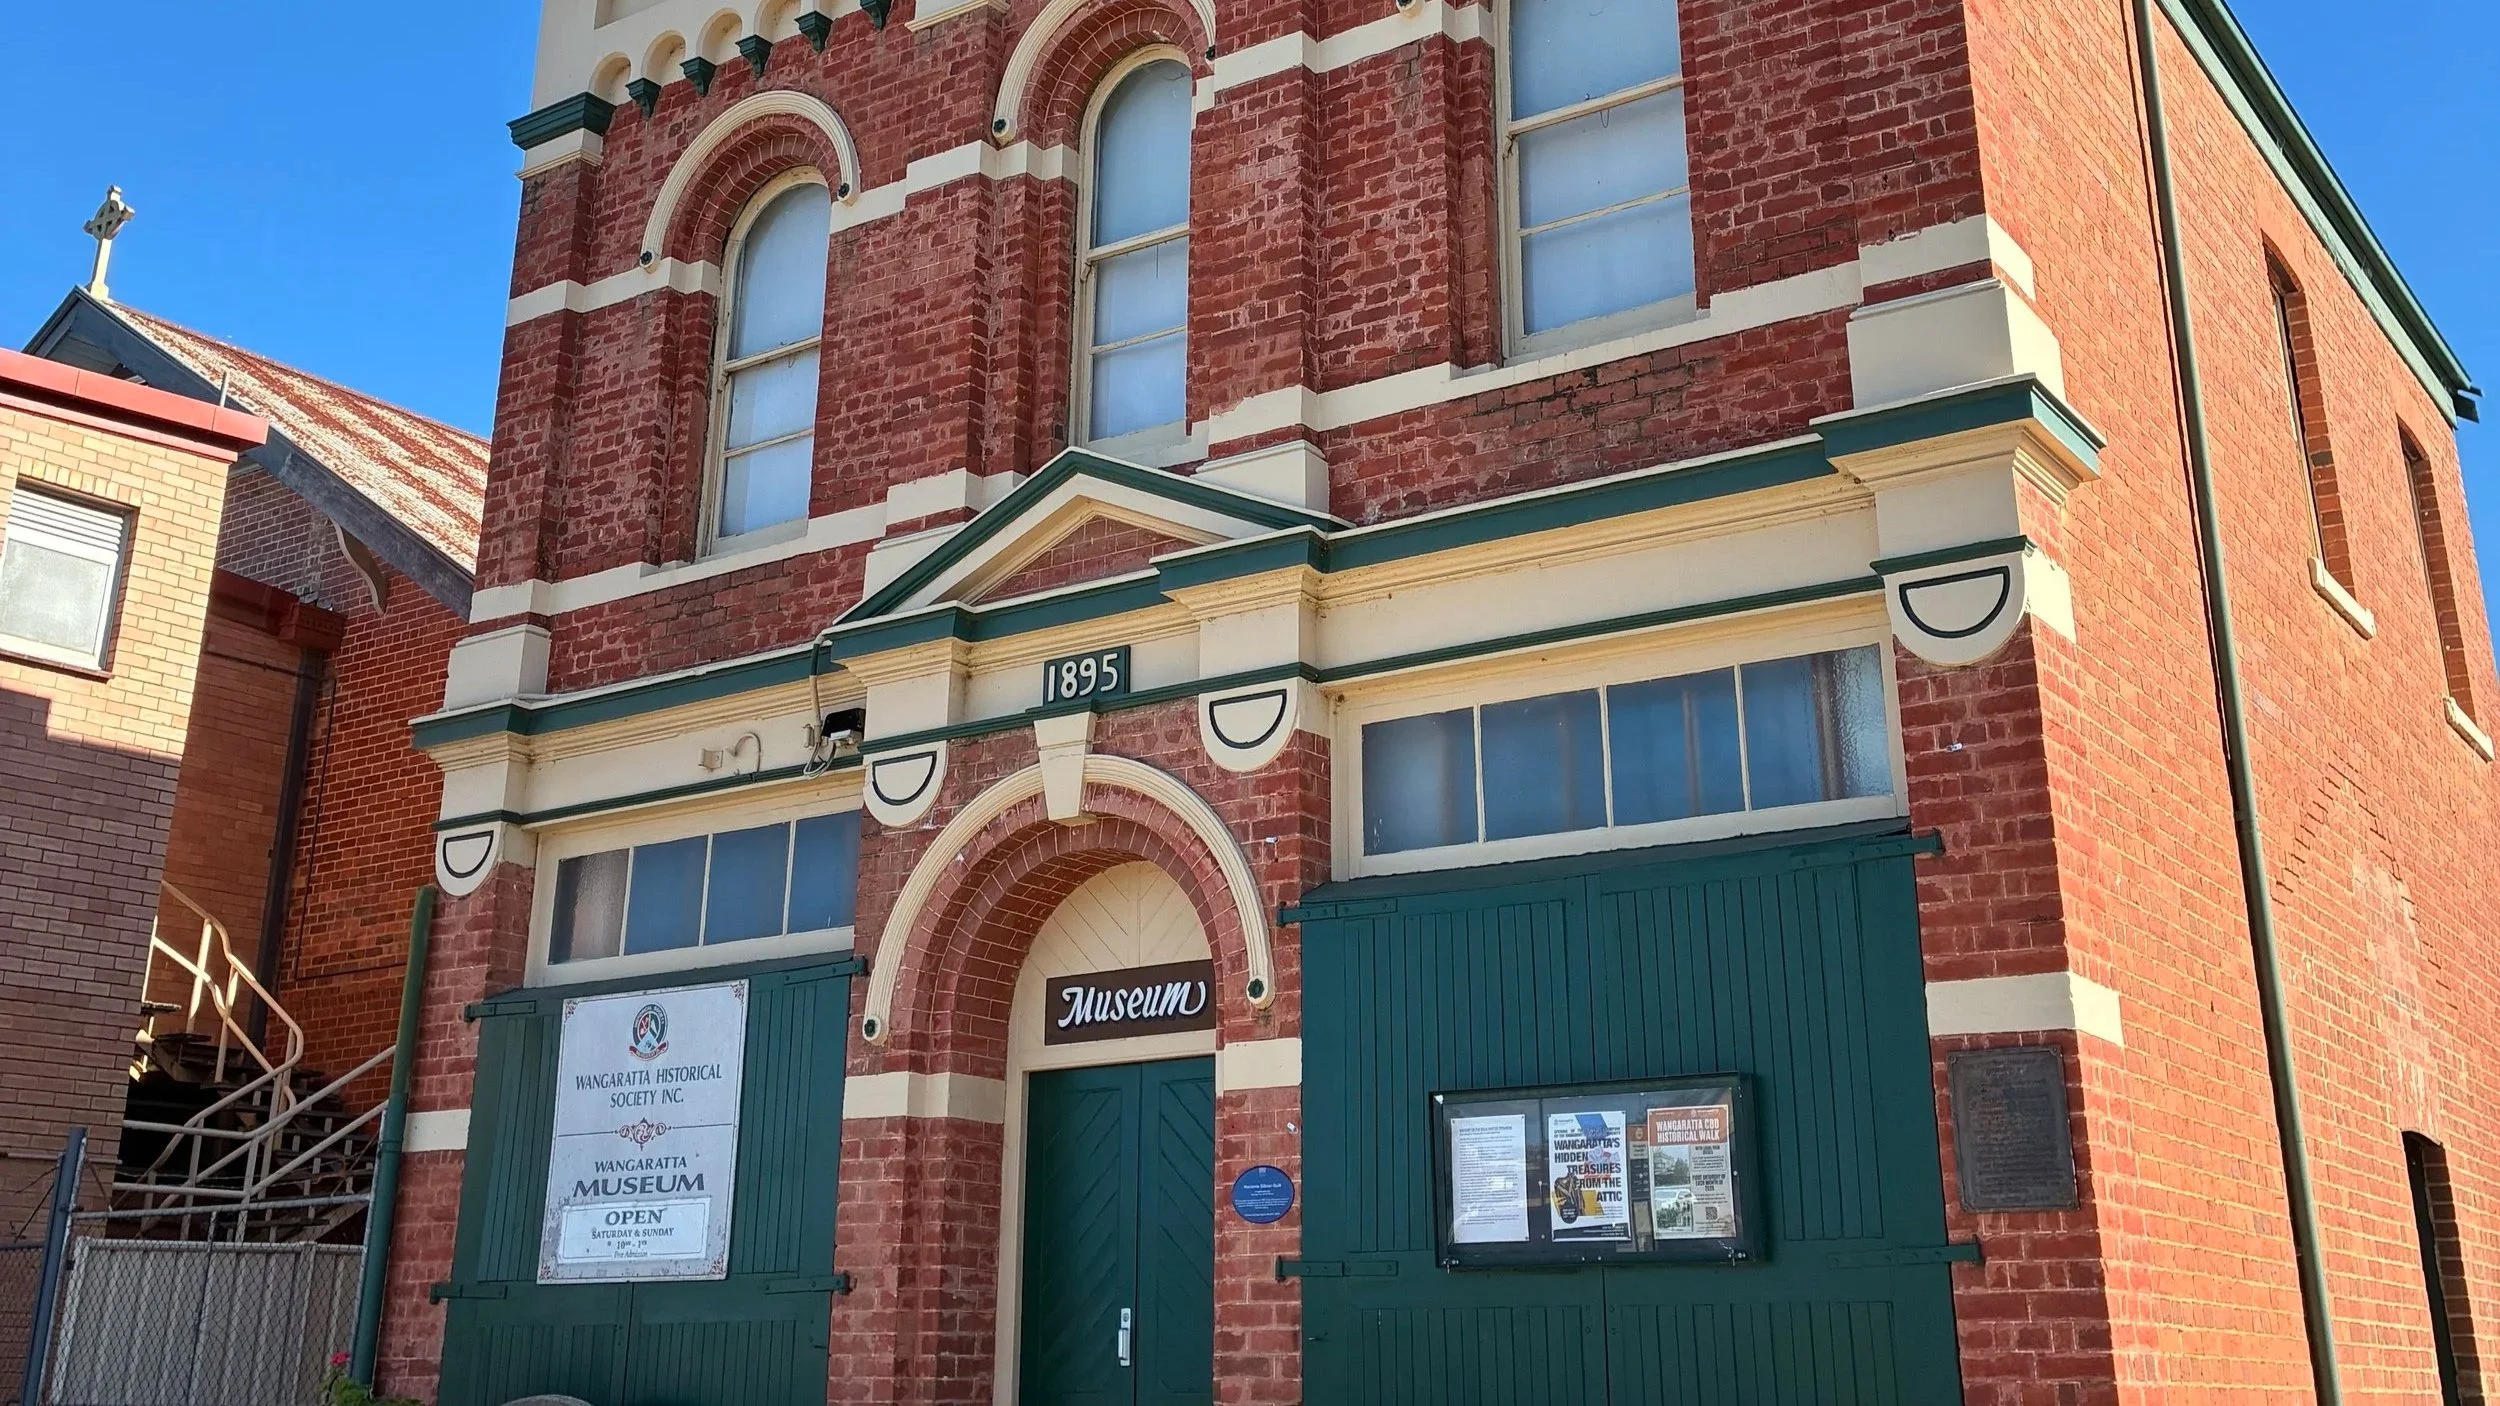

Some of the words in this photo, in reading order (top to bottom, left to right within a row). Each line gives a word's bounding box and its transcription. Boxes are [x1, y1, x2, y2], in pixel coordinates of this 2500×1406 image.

[1047, 653, 1119, 703] 1895
[1057, 980, 1206, 1030] Museum
[576, 1070, 650, 1090] WANGARATTA
[656, 1064, 722, 1084] HISTORICAL
[610, 1090, 657, 1108] SOCIETY
[662, 1088, 684, 1104] INC.
[1656, 1119, 1703, 1132] WANGARATTA
[1704, 1118, 1720, 1130] CBD
[1657, 1131, 1698, 1143] HISTORICAL
[1699, 1129, 1720, 1141] WALK
[1554, 1138, 1620, 1150] WANGARATTA'S
[1554, 1151, 1588, 1163] HIDDEN
[595, 1156, 687, 1173] WANGARATTA
[1567, 1163, 1621, 1175] TREASURES
[573, 1173, 705, 1197] MUSEUM
[1575, 1178, 1602, 1189] FROM
[1603, 1177, 1622, 1188] THE
[1597, 1191, 1622, 1202] ATTIC
[605, 1208, 667, 1226] OPEN
[592, 1229, 632, 1239] SATURDAY
[634, 1229, 641, 1238] &
[642, 1227, 675, 1237] SUNDAY
